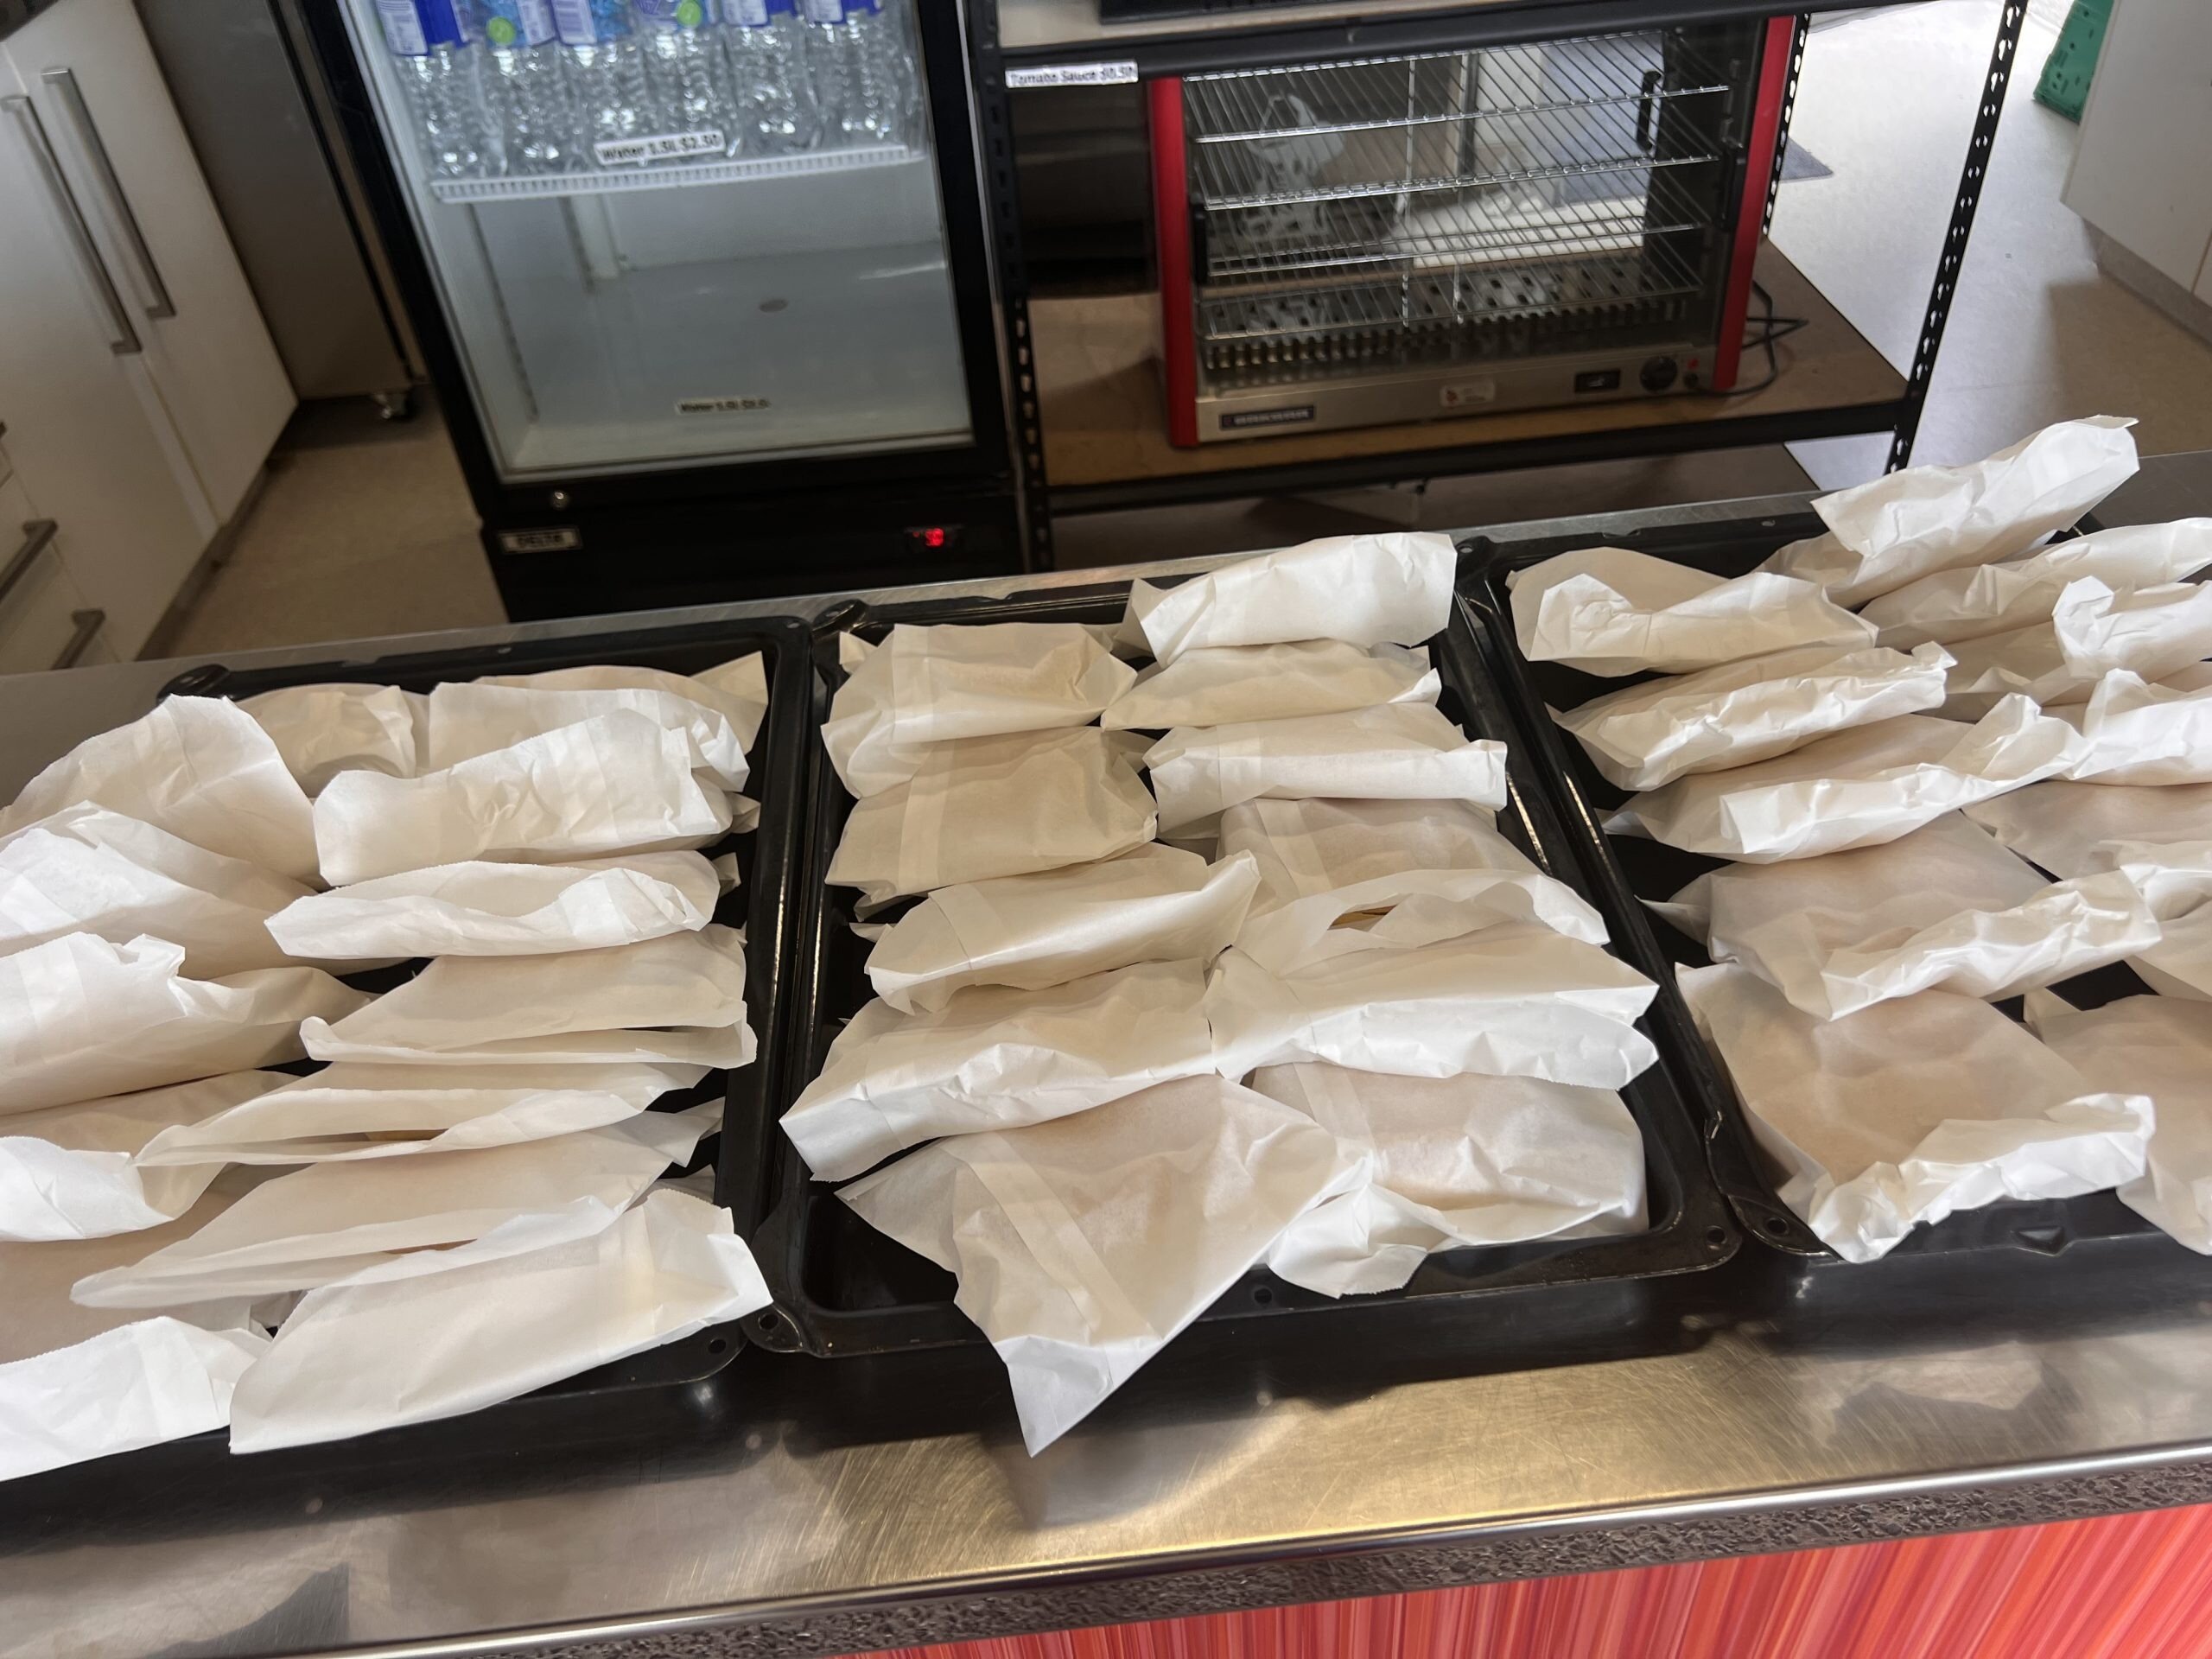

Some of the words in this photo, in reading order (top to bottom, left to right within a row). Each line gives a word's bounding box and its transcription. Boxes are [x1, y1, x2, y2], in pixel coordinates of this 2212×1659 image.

[1009, 71, 1058, 85] Tomato
[1060, 69, 1098, 83] Sauce
[602, 146, 645, 159] Water
